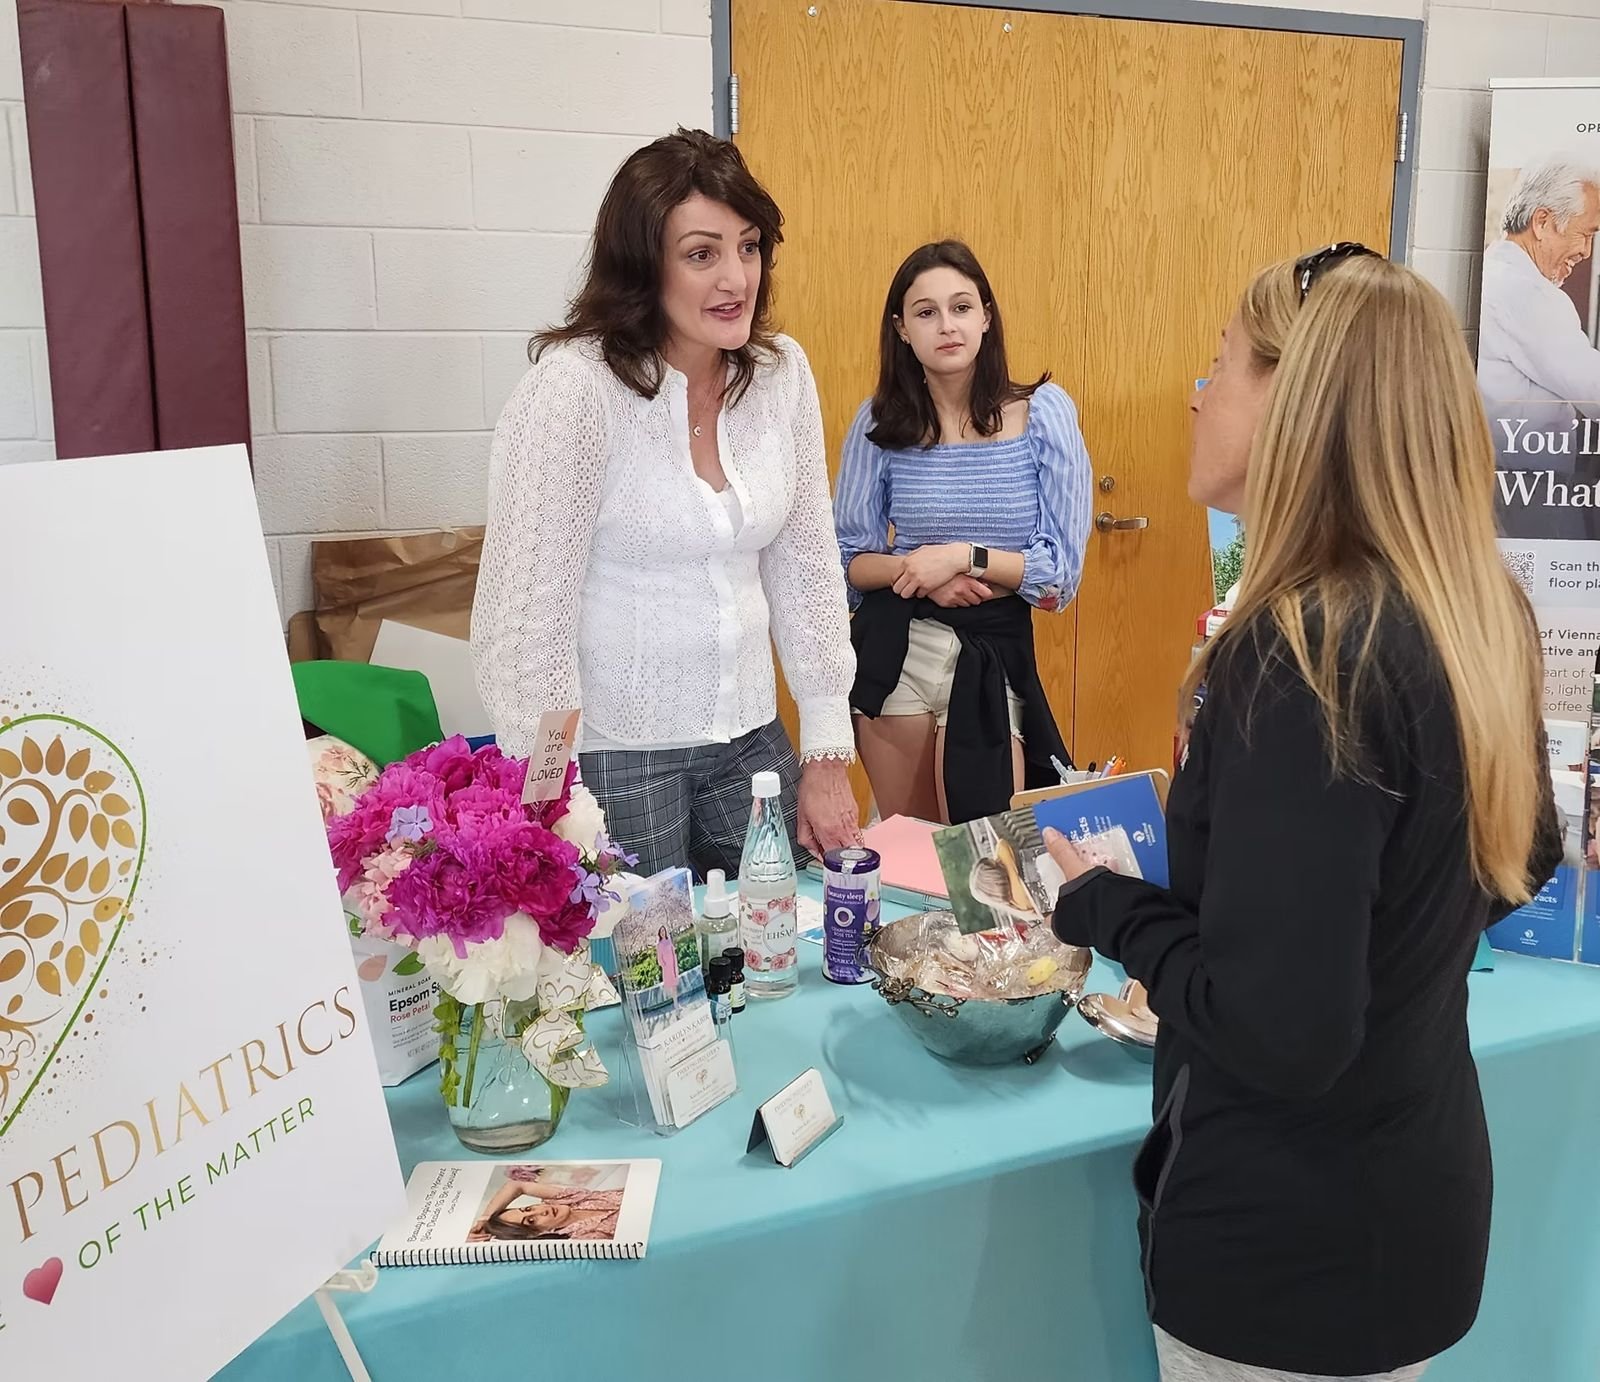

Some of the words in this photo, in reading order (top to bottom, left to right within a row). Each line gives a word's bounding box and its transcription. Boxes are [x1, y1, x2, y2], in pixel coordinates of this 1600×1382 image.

[1493, 470, 1600, 508] What
[1550, 561, 1582, 571] Scan
[1549, 577, 1582, 589] floor
[1586, 578, 1600, 591] pl
[1557, 629, 1600, 640] Vienna
[1572, 667, 1586, 679] of
[1558, 683, 1592, 697] light-
[1543, 700, 1582, 712] coffee
[548, 729, 568, 741] You
[544, 742, 563, 753] are
[544, 756, 557, 766] so
[530, 767, 564, 782] LOVED
[847, 892, 864, 902] sleep
[388, 984, 417, 996] MINERAL
[389, 988, 430, 1012] Epsom
[390, 1012, 411, 1024] Rose
[412, 1000, 431, 1015] Petal
[6, 986, 357, 1242] PEDIATRICS
[79, 1222, 121, 1269] OF
[133, 1174, 196, 1232] THE
[206, 1097, 316, 1185] MATTER
